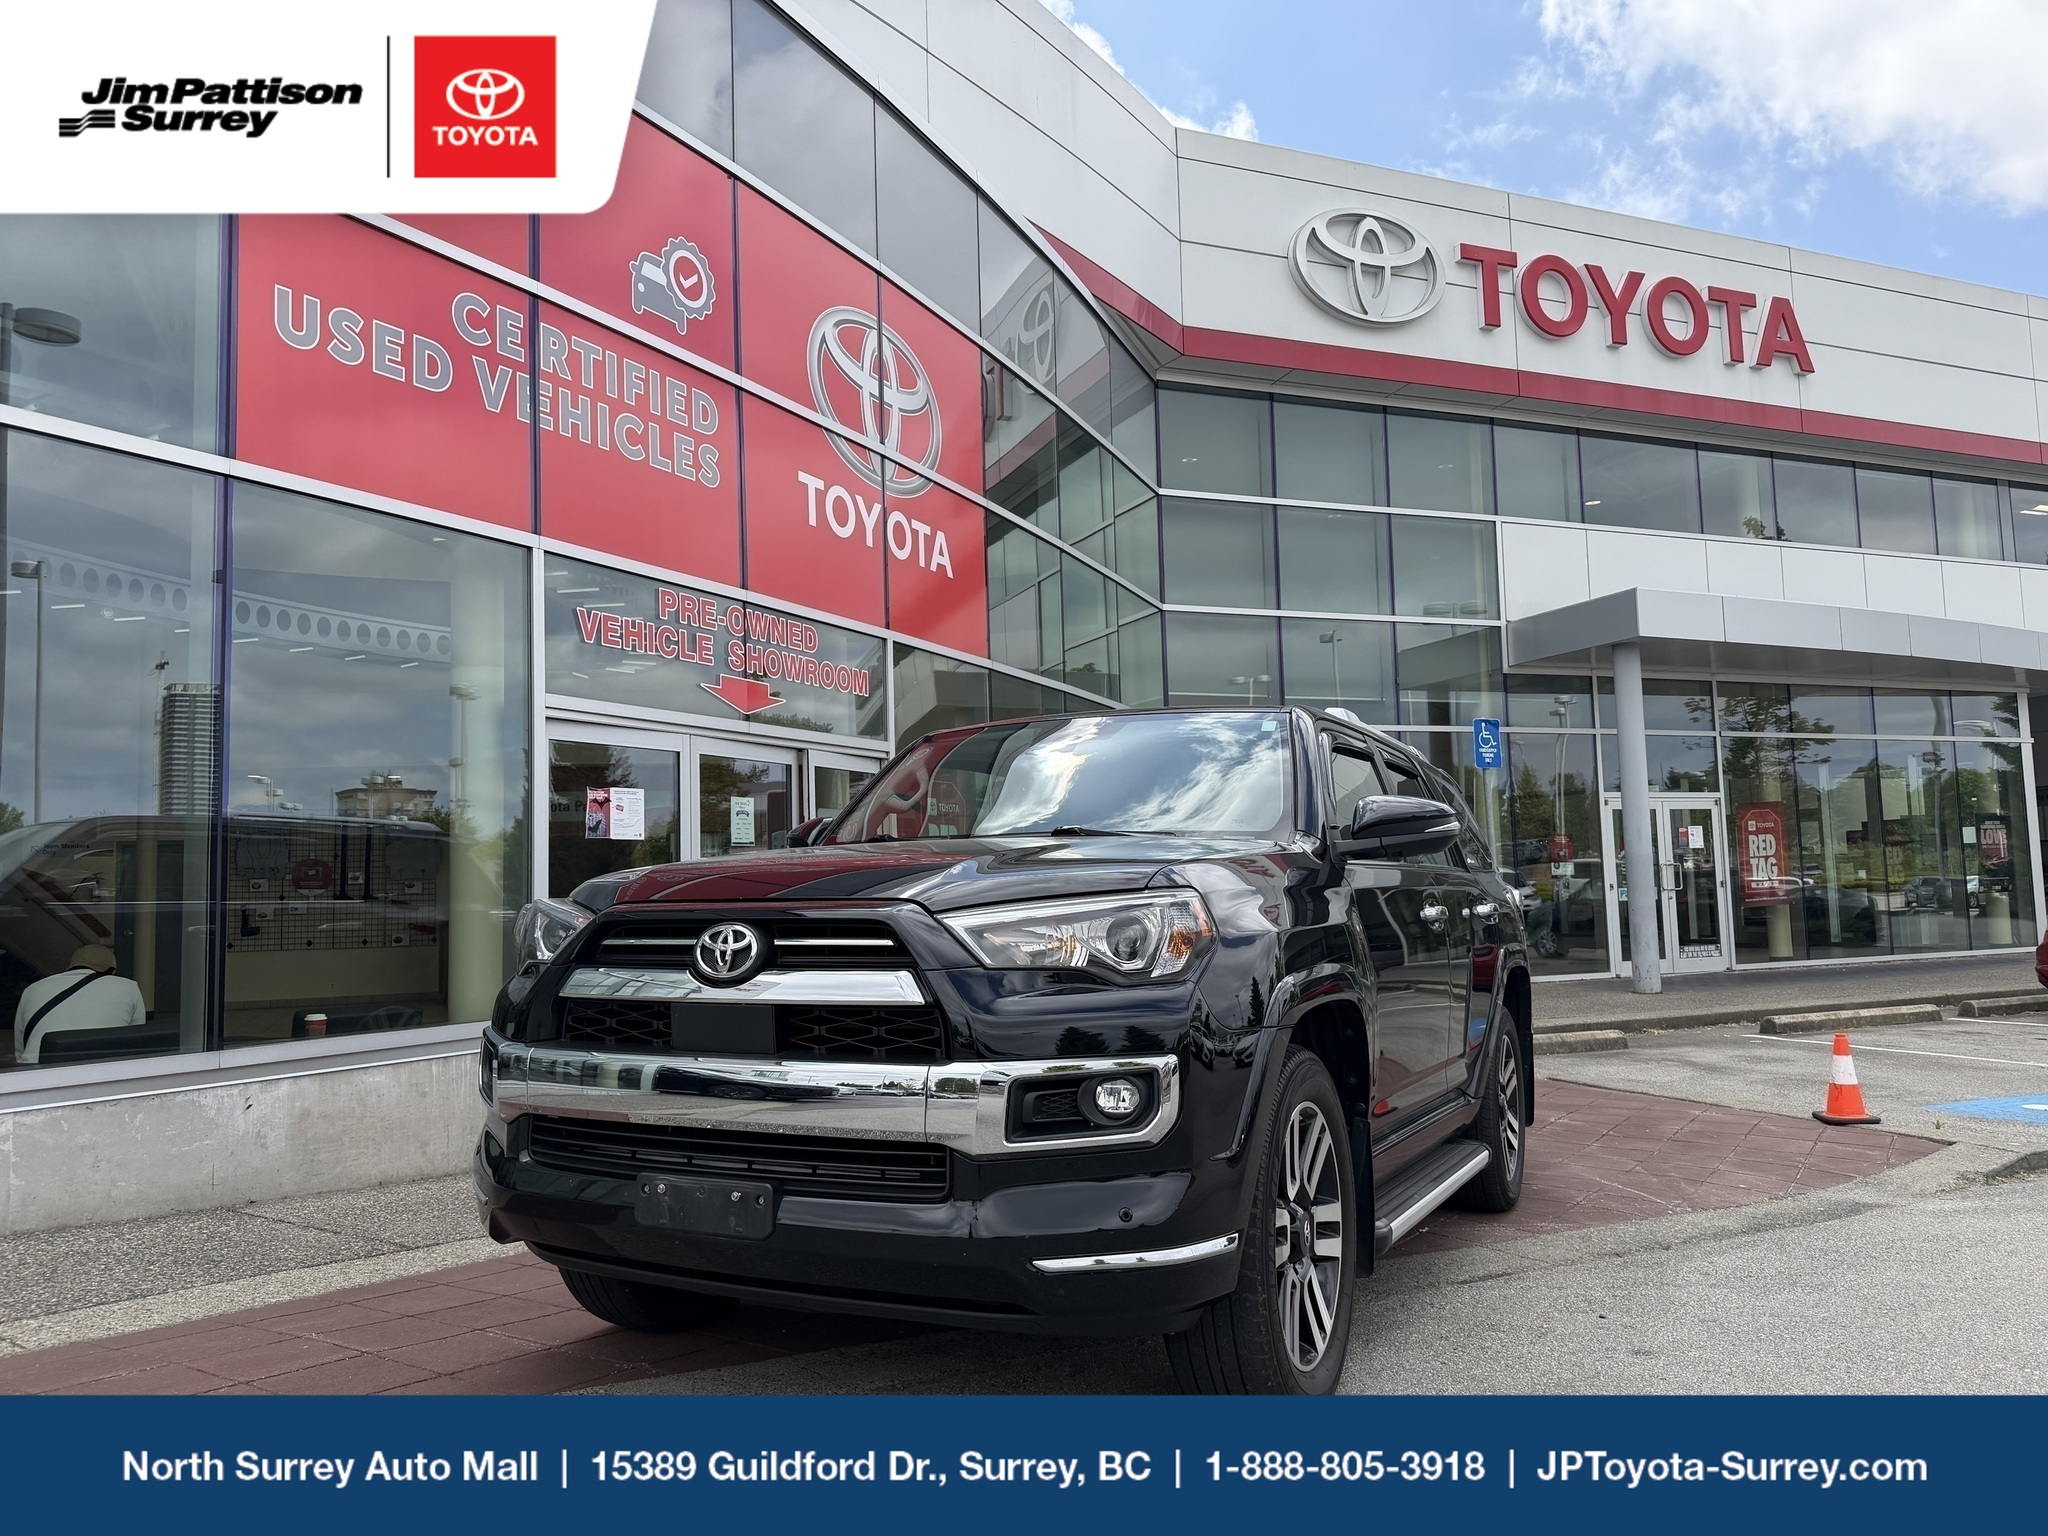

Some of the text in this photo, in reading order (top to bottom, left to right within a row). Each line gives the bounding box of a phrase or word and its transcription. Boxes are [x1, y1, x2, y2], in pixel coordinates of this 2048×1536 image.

[1454, 242, 1815, 376] TOYOTA
[273, 283, 720, 488] USED VEHICLES
[451, 292, 719, 435] CERTIFIED
[797, 470, 954, 579] TOYOTA
[575, 607, 870, 698] VEHICLE SHOWROOM
[657, 587, 819, 654] PRE-OWNED
[938, 803, 960, 813] TOYOTA
[1748, 833, 1777, 857] RED
[1980, 828, 2008, 845] LOVE
[1749, 857, 1778, 880] TAG
